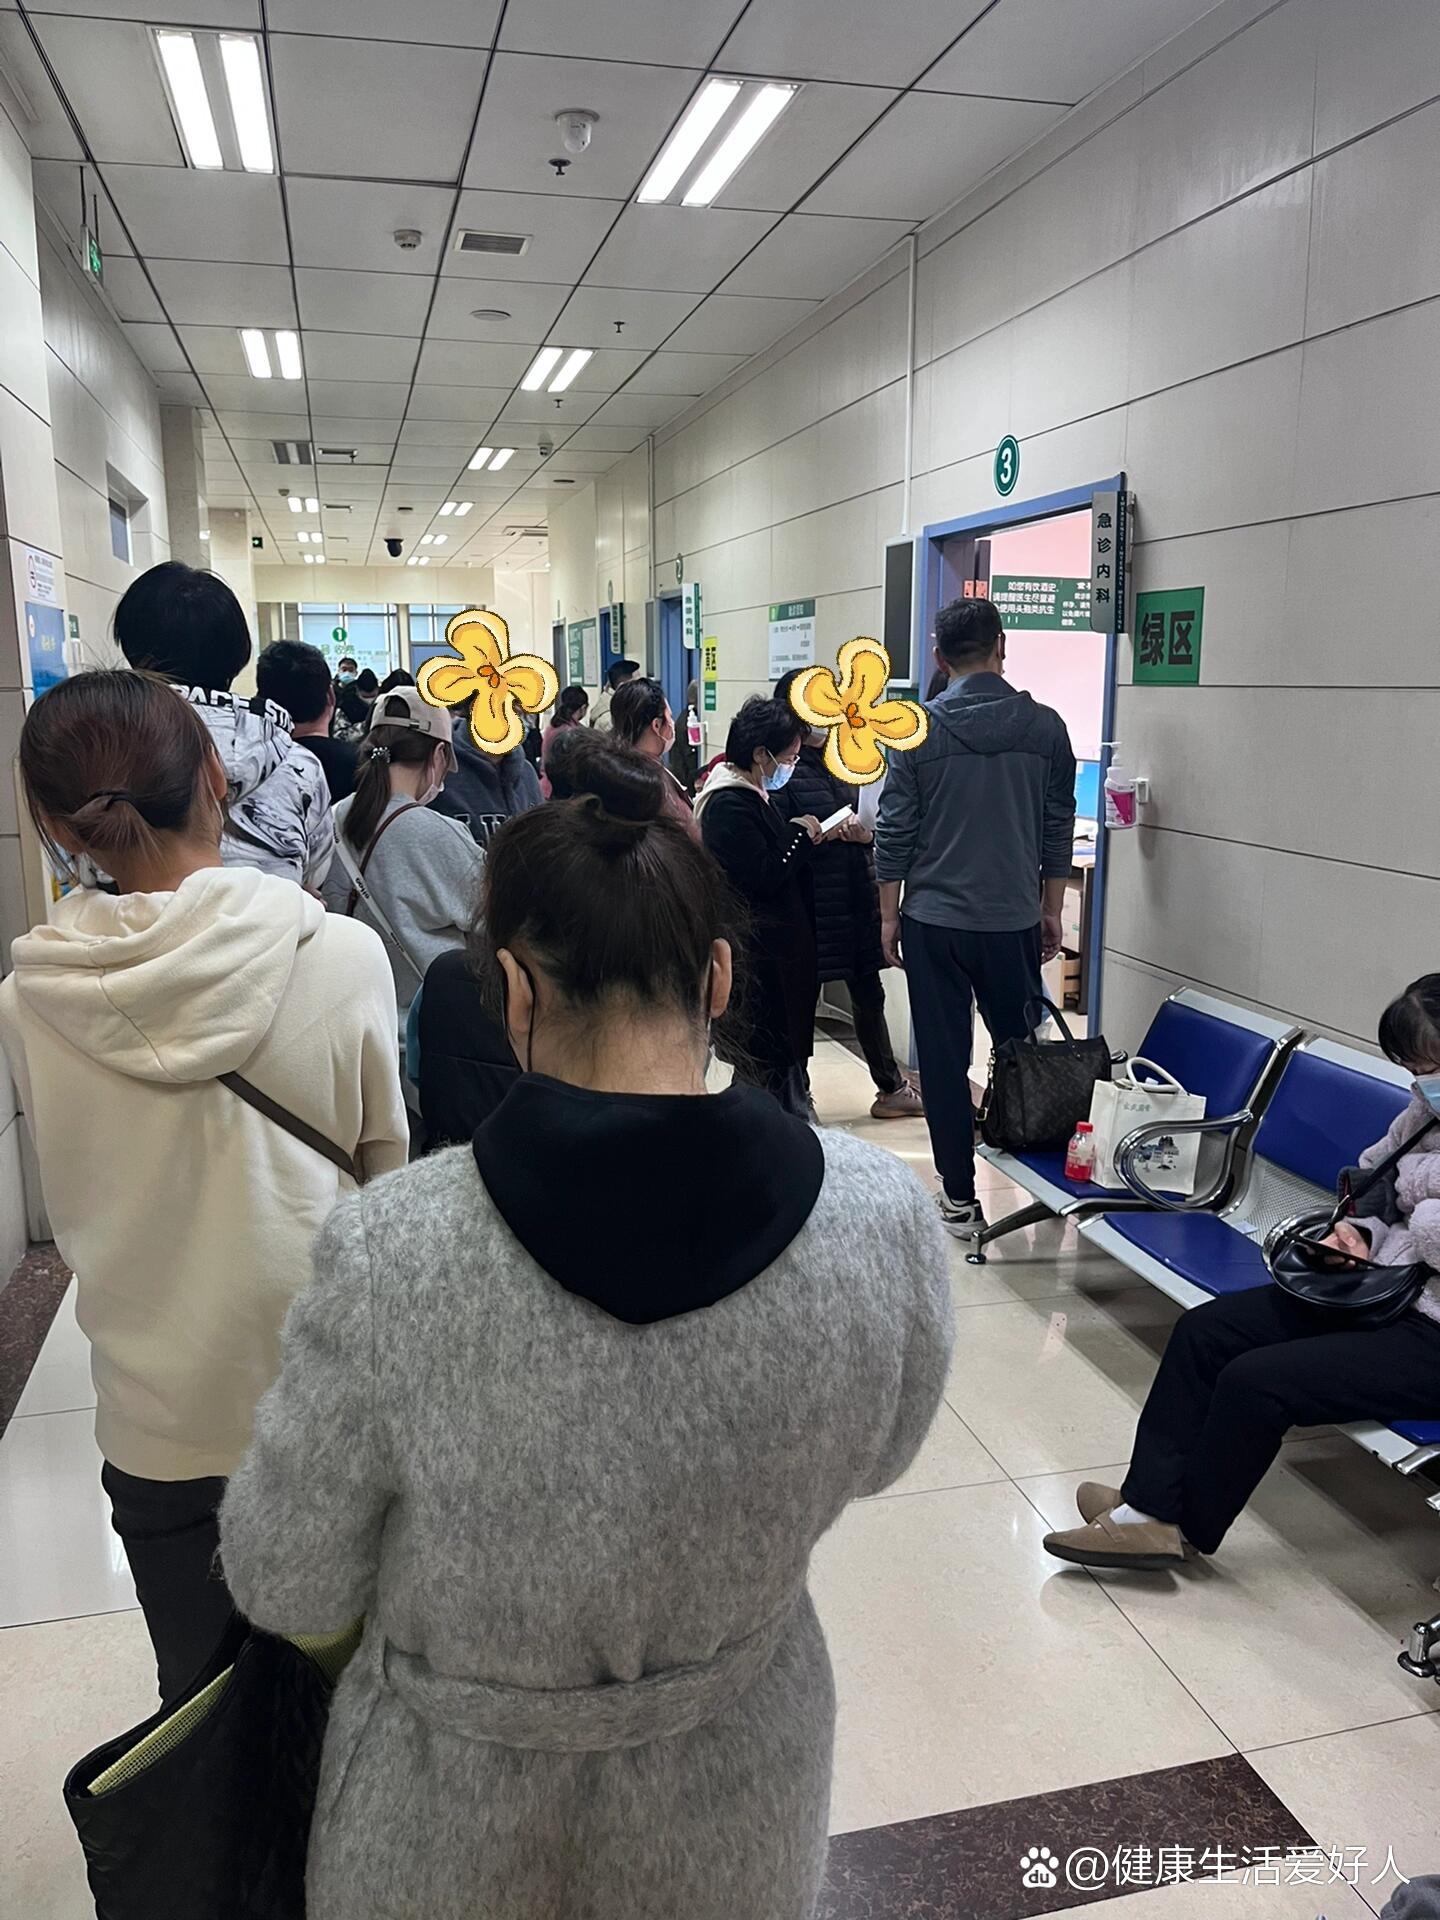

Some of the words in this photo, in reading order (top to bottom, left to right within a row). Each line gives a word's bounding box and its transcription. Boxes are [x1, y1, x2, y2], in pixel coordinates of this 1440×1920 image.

[1001, 447, 1012, 484] 3
[1096, 512, 1112, 603] 急诊内科
[336, 629, 343, 640] 1
[1140, 610, 1195, 666] 绿区
